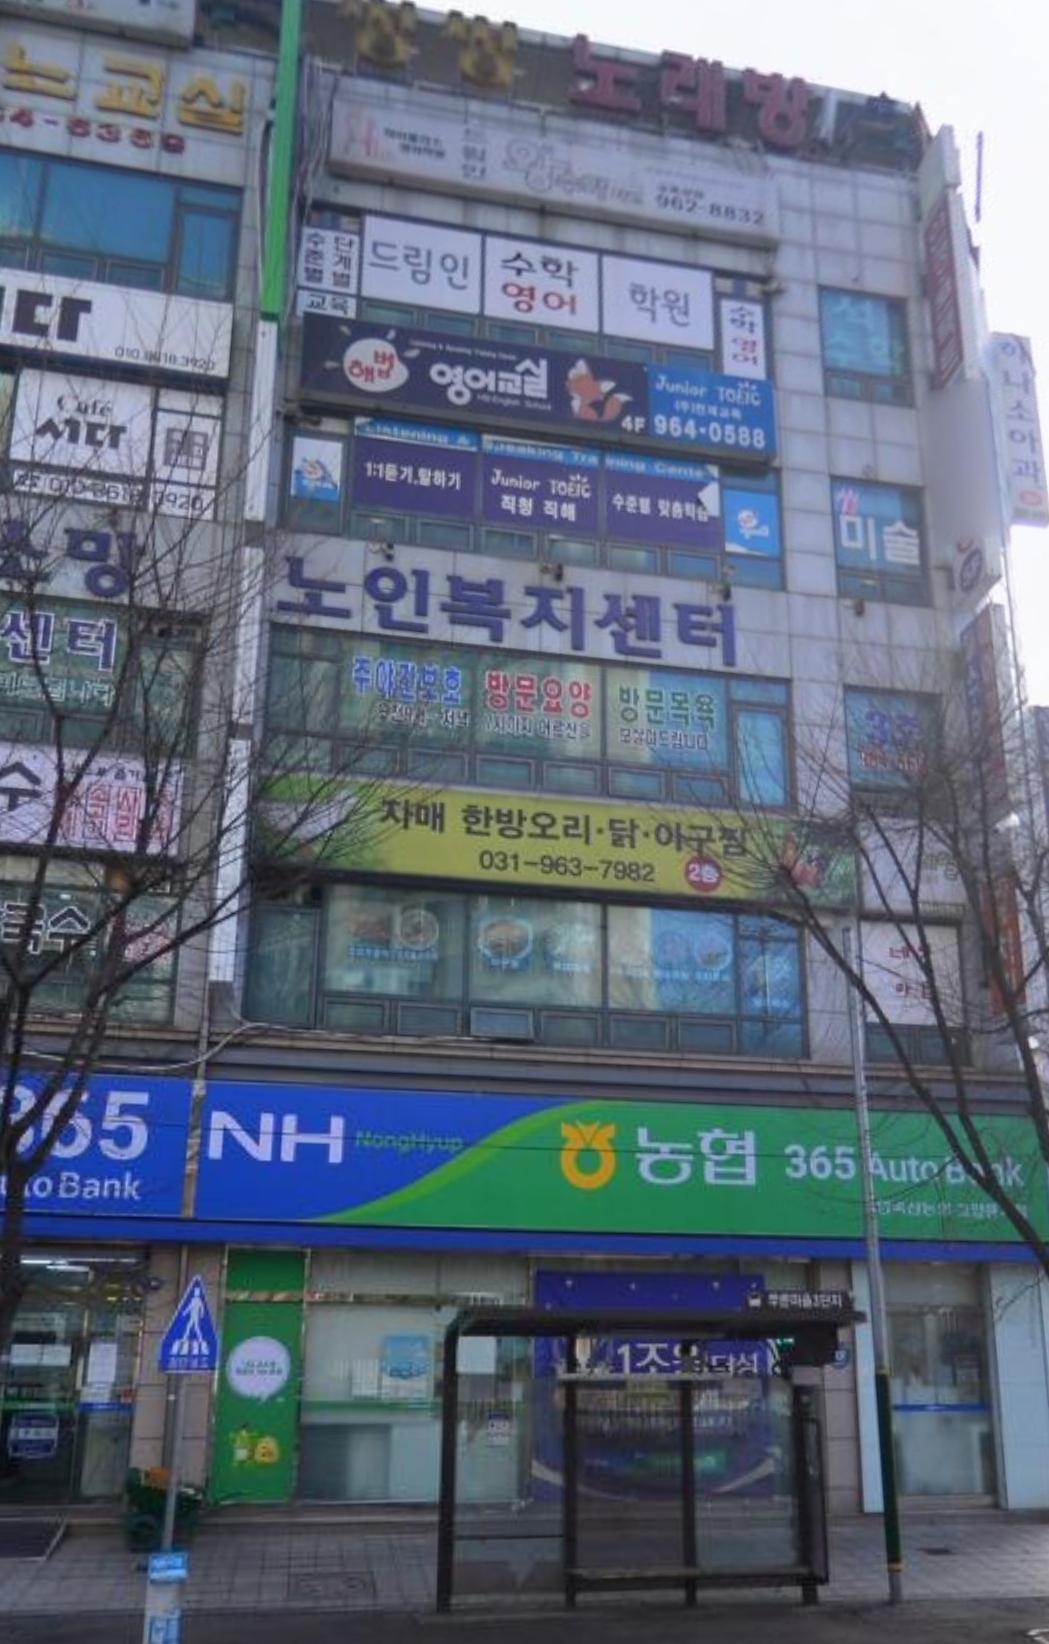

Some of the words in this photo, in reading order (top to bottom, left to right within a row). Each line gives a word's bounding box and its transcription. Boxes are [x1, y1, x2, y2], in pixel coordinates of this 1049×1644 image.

[568, 33, 812, 147] 노래방
[656, 193, 765, 225] 962-8832
[367, 240, 470, 290] 드림인
[501, 251, 579, 288] 수학
[0, 286, 92, 342] 다
[501, 280, 577, 316] 영어
[628, 281, 690, 326] 학원
[348, 349, 394, 383] 해법
[429, 357, 548, 406] 영어교실
[656, 374, 708, 396] Junior
[718, 381, 761, 407] TOEIC
[621, 415, 646, 433] 4F
[490, 469, 540, 491] Junior
[550, 474, 592, 498] TOEIC
[839, 515, 921, 567] 미술
[276, 556, 736, 666] 노인복지센터
[486, 670, 590, 718] 방문요양
[619, 685, 716, 730] 방문목욕
[381, 799, 446, 833] 자매
[479, 850, 656, 883] 031-963-7982
[208, 1111, 344, 1164] NH
[356, 1129, 464, 1152] NongHyup
[636, 1126, 757, 1187] 농협
[785, 1145, 856, 1181] 365
[869, 1151, 938, 1184] Auto
[58, 1171, 143, 1201] Bank
